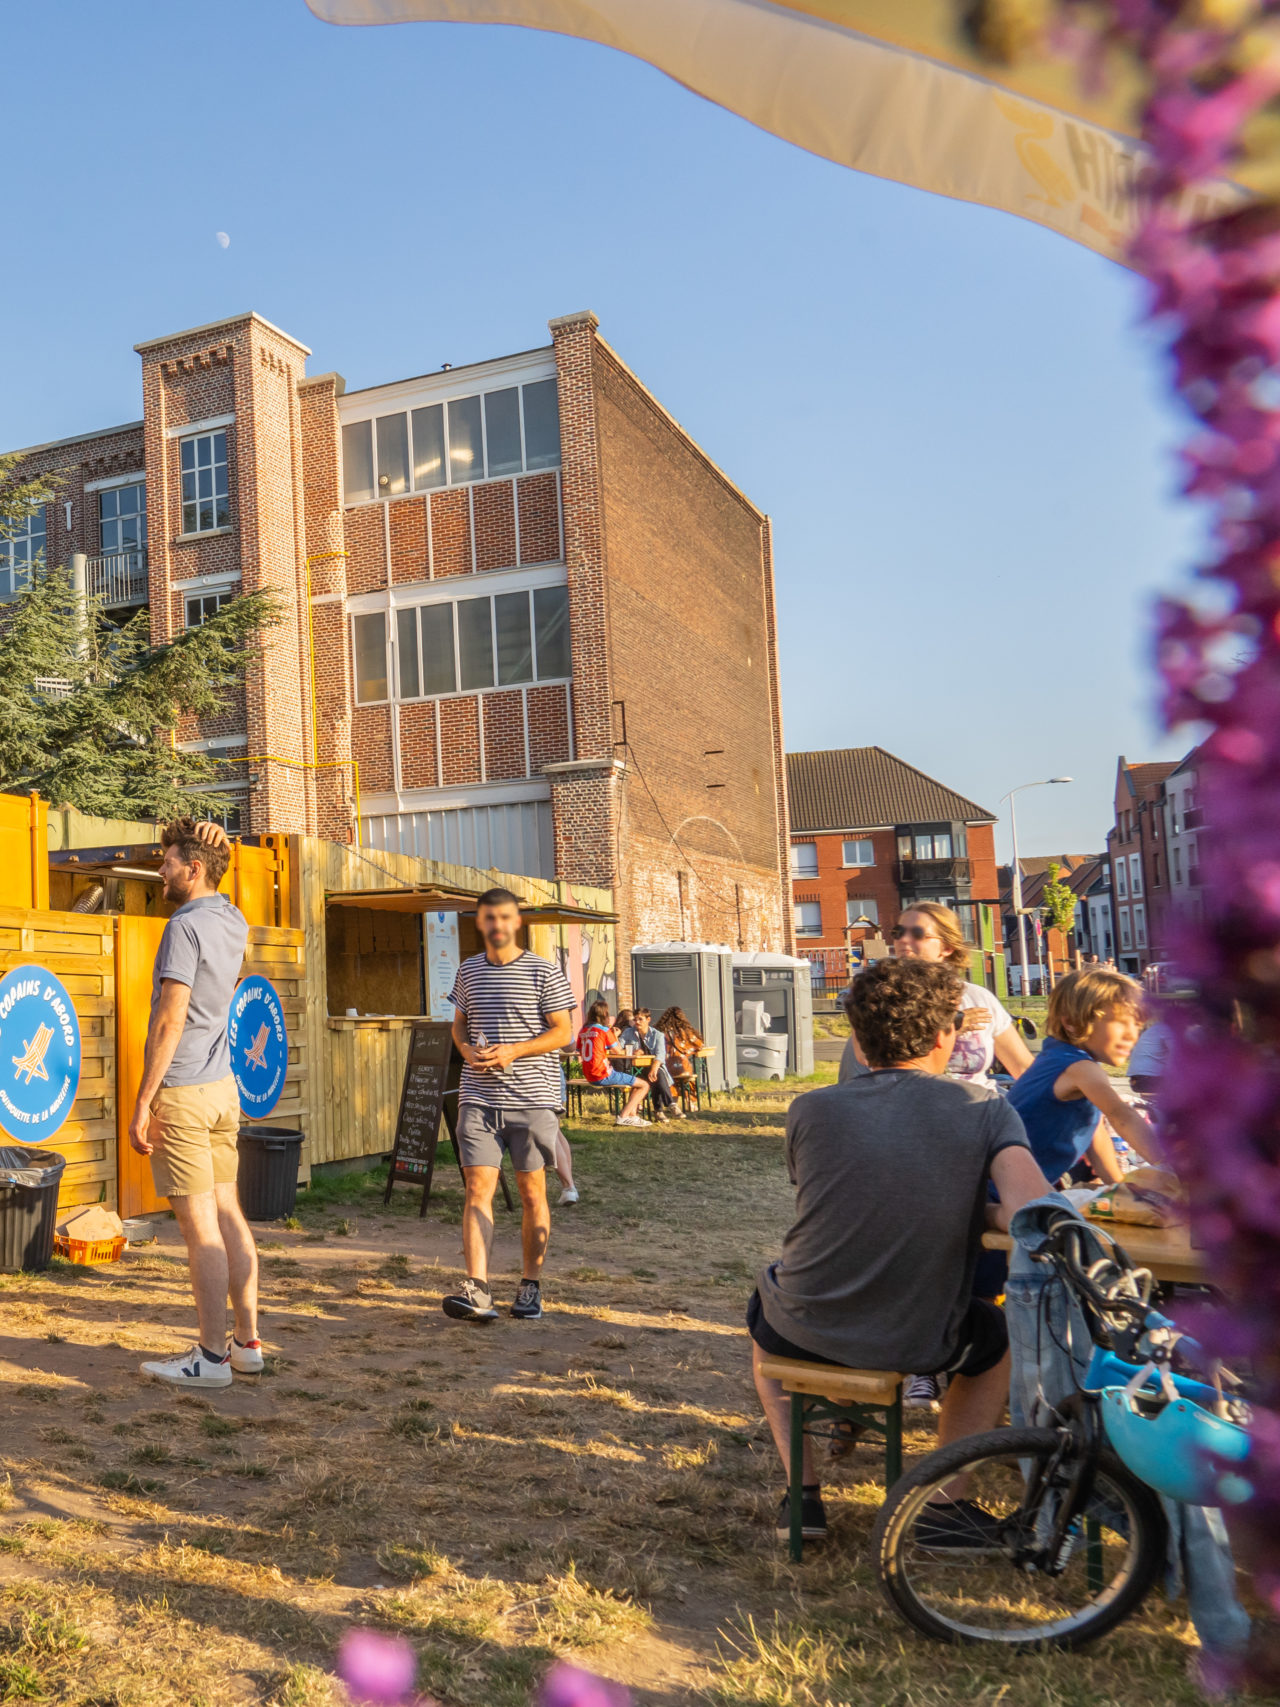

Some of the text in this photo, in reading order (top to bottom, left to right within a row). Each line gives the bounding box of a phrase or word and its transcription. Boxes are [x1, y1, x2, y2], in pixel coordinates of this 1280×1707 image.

[43, 985, 75, 1048] D'ABORD
[229, 986, 284, 1048] LES COPAINS D'ABORD
[31, 1112, 41, 1124] DE
[41, 1109, 49, 1122] LA
[49, 1074, 71, 1116] MADELEINE
[256, 1094, 262, 1103] DE
[261, 1090, 268, 1102] LA
